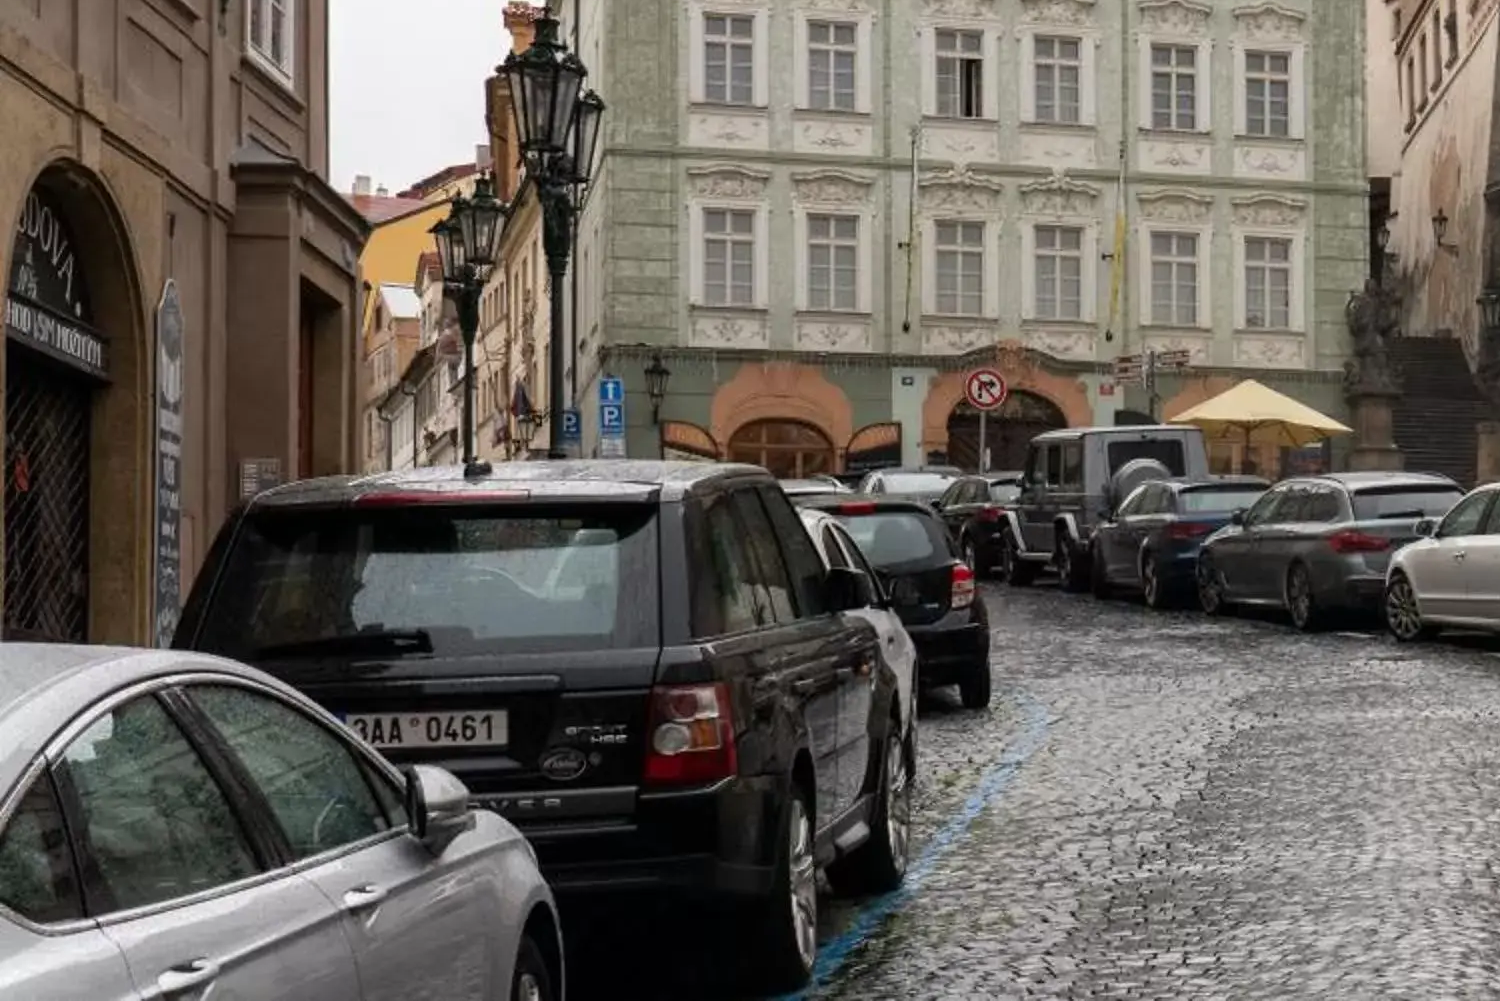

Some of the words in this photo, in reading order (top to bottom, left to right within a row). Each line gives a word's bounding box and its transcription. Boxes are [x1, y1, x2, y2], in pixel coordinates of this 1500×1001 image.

[603, 406, 619, 426] P
[352, 714, 403, 744] 3AA
[425, 714, 494, 743] 0461
